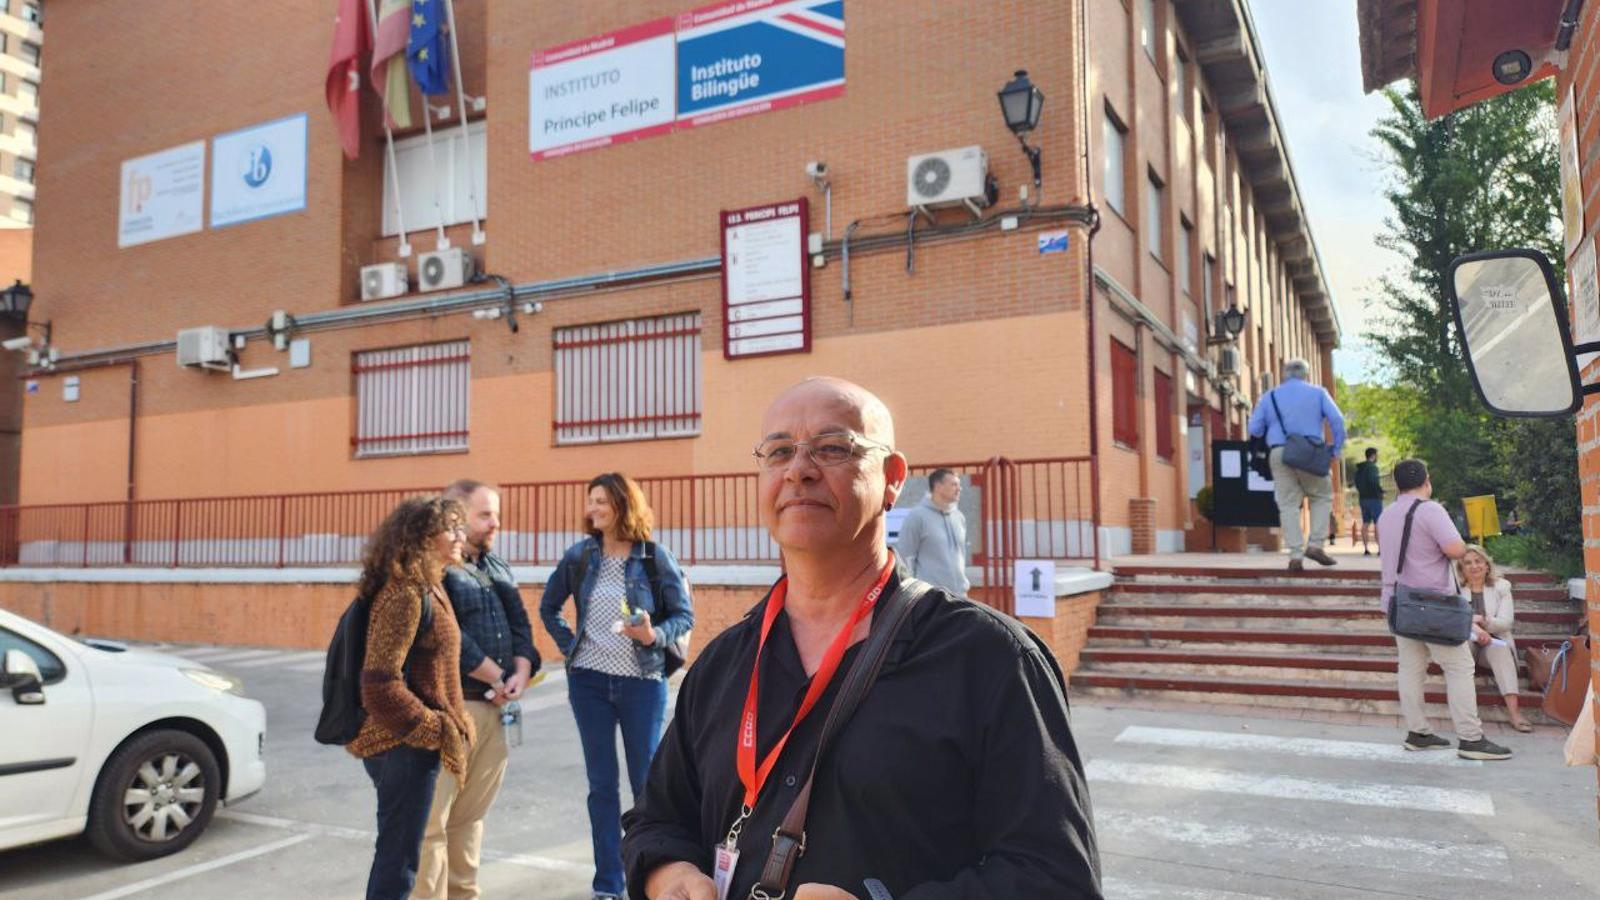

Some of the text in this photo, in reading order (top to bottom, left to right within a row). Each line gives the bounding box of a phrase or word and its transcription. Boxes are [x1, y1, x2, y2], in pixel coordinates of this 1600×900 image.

[691, 52, 762, 82] Instituto
[545, 69, 621, 100] INSTITUTO
[691, 72, 760, 102] Bilingüe
[610, 96, 660, 120] Felipe
